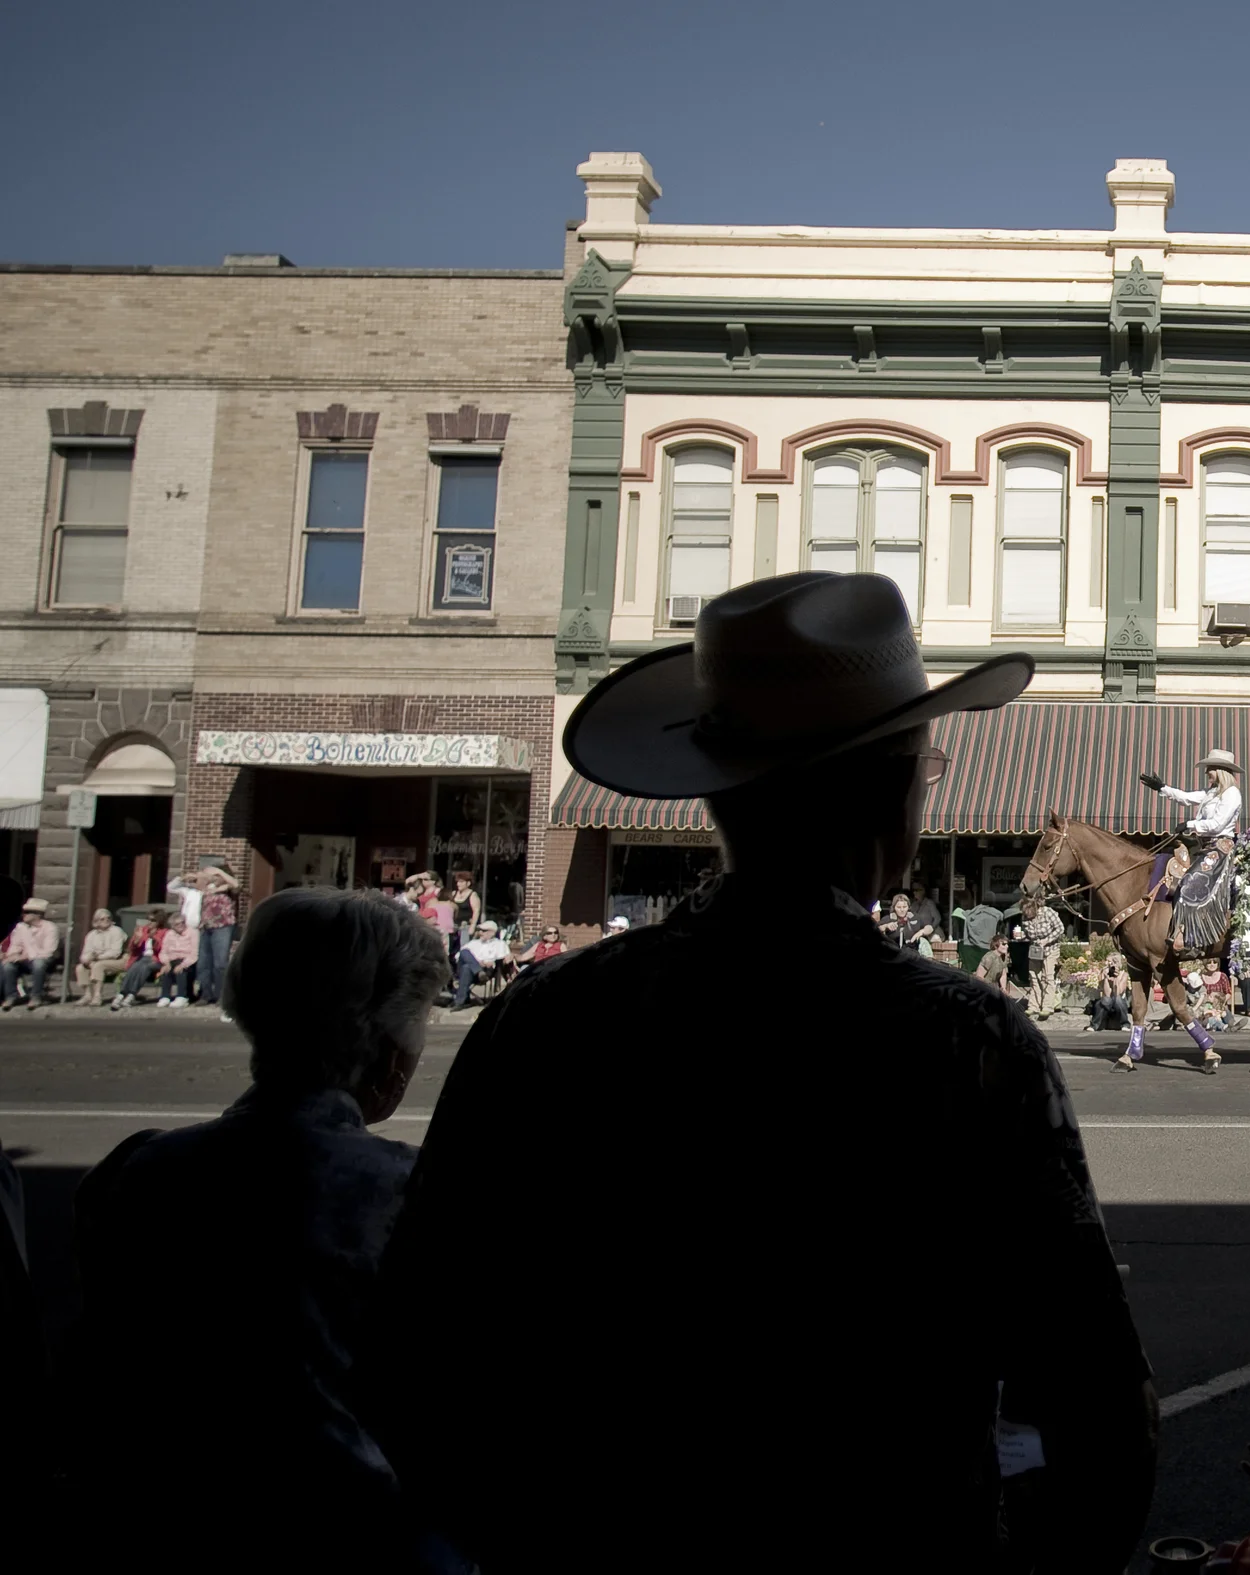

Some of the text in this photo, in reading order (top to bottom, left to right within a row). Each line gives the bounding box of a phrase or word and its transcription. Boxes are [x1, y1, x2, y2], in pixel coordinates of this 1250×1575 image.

[306, 735, 418, 763] Bohemian
[625, 832, 713, 844] BEARS CARDS
